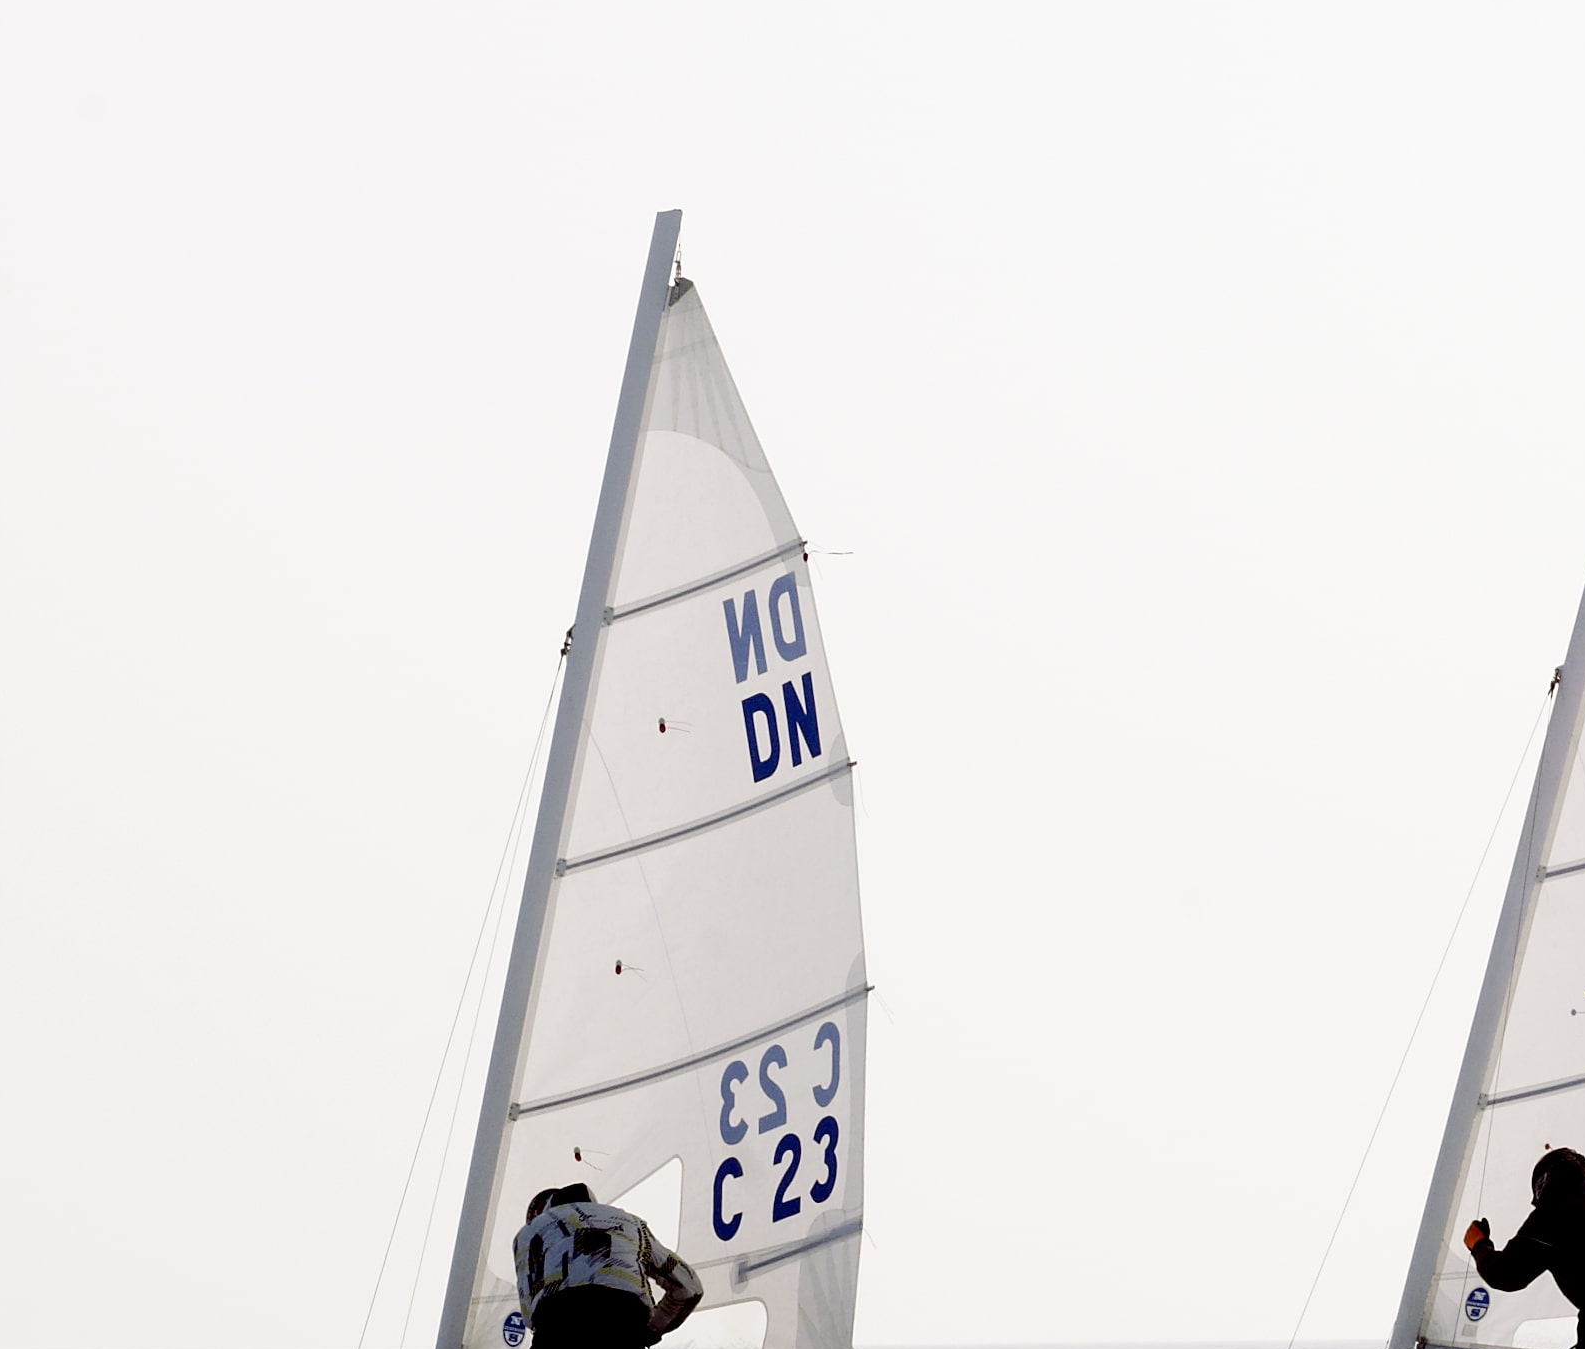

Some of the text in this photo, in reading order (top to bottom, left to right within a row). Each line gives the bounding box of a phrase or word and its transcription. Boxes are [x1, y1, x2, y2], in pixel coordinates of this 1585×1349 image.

[742, 672, 821, 783] DN
[712, 1116, 839, 1241] C 23
